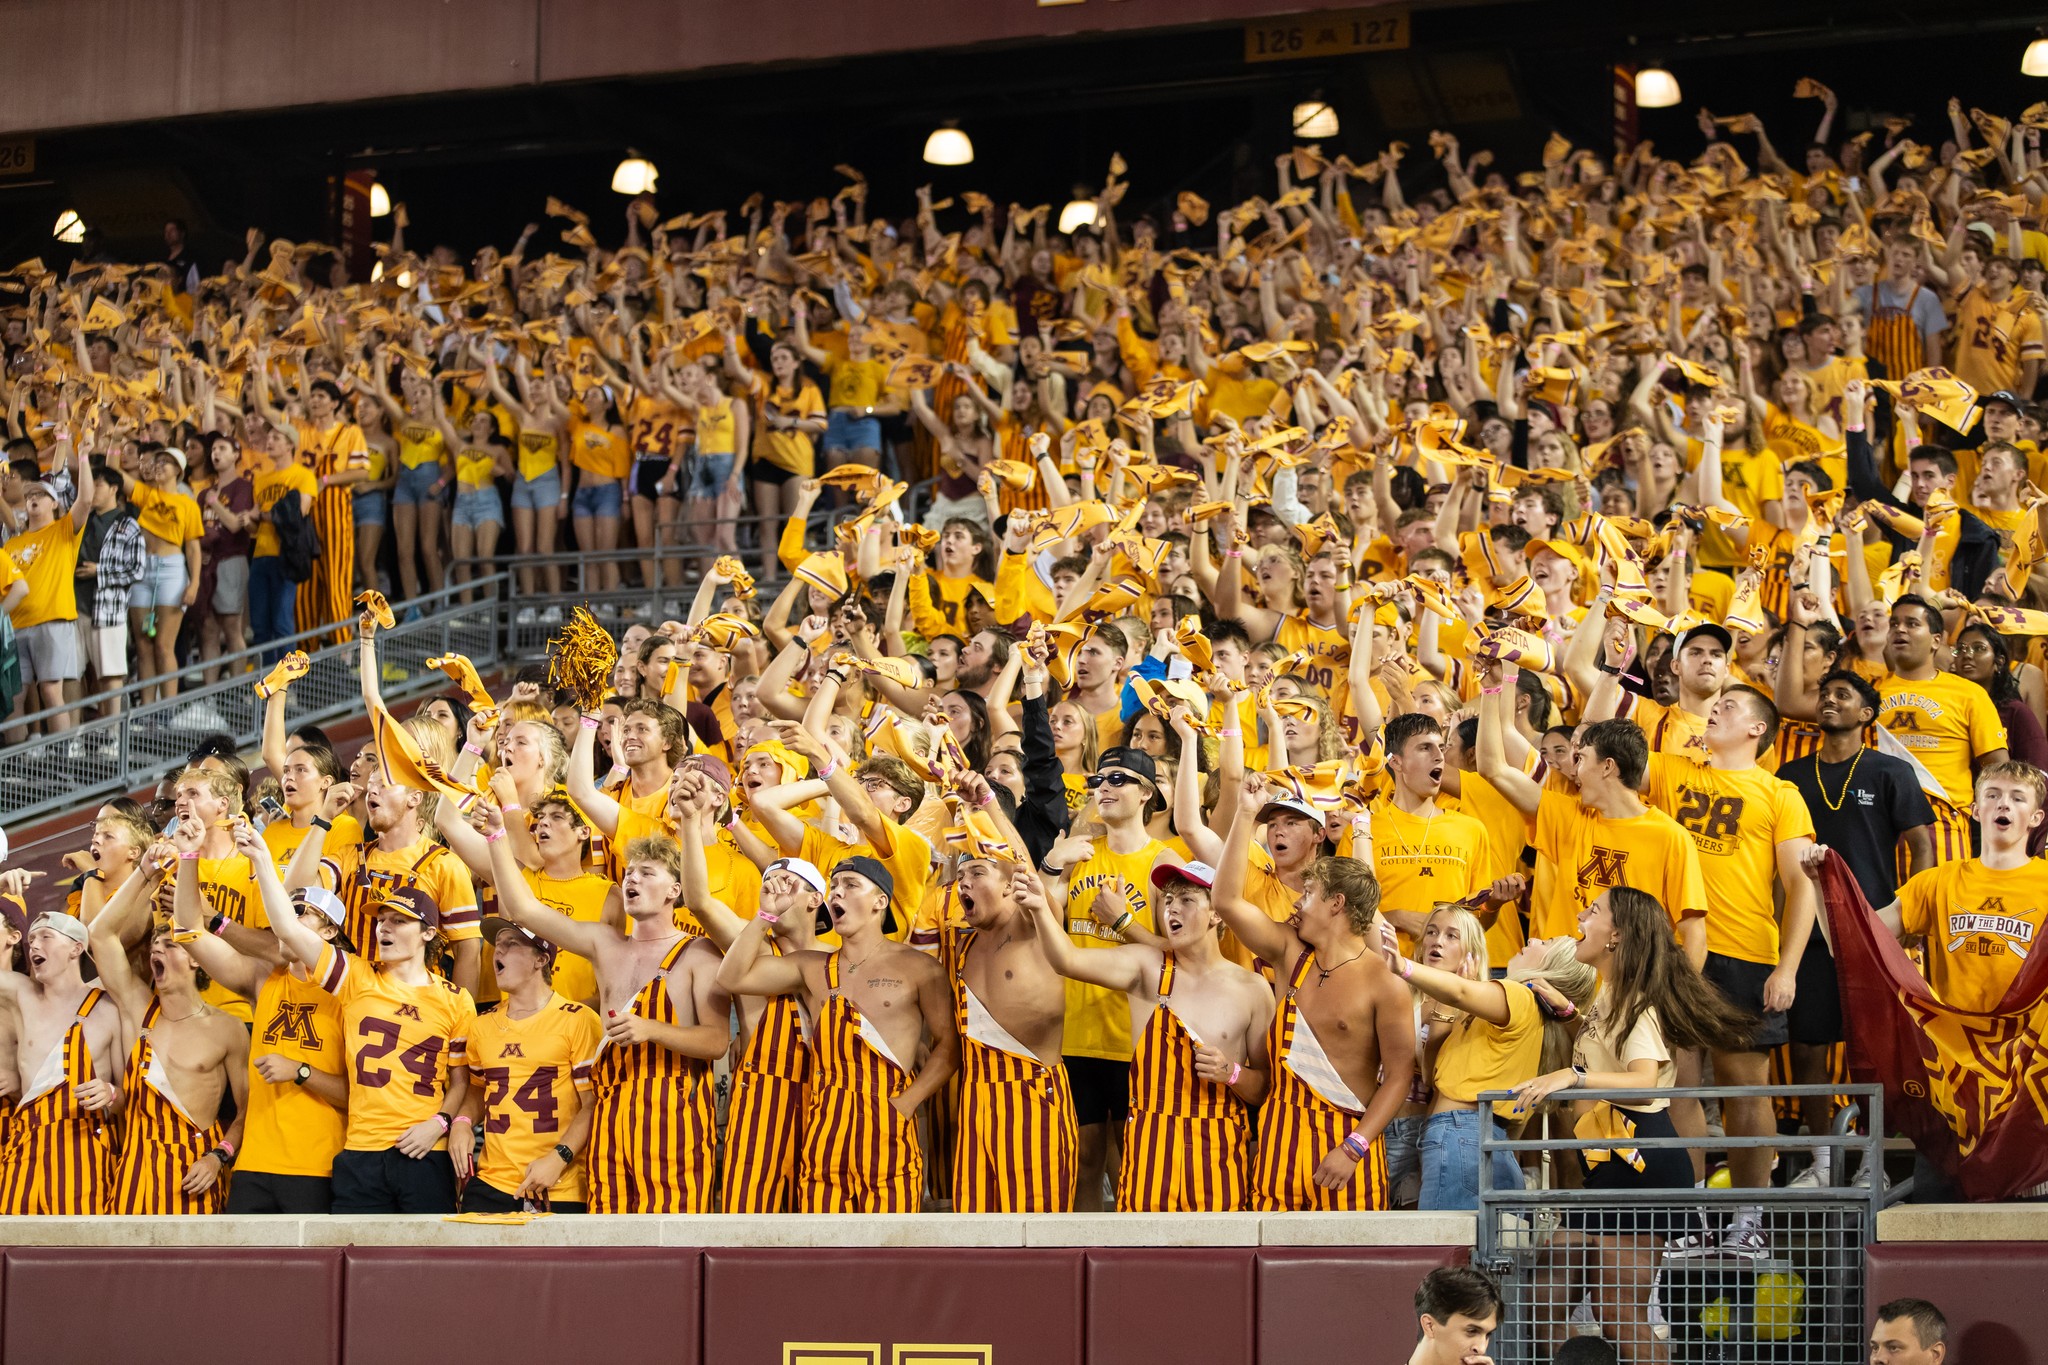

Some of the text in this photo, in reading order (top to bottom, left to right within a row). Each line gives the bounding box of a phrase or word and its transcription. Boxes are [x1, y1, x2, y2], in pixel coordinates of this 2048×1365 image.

[1255, 28, 1304, 54] 126
[1352, 18, 1399, 45] 127
[636, 419, 673, 455] 24
[1306, 663, 1333, 690] 00
[1676, 789, 1745, 841] 28
[1381, 857, 1422, 867] GOLDEN
[1070, 874, 1147, 913] MINNOTA
[1072, 920, 1096, 934] GOLDEN
[1950, 915, 2031, 938] ROW THE BOAT
[1965, 943, 1977, 952] SKI
[263, 1000, 323, 1051] M
[356, 1015, 445, 1097] 24
[485, 1066, 559, 1134] 24
